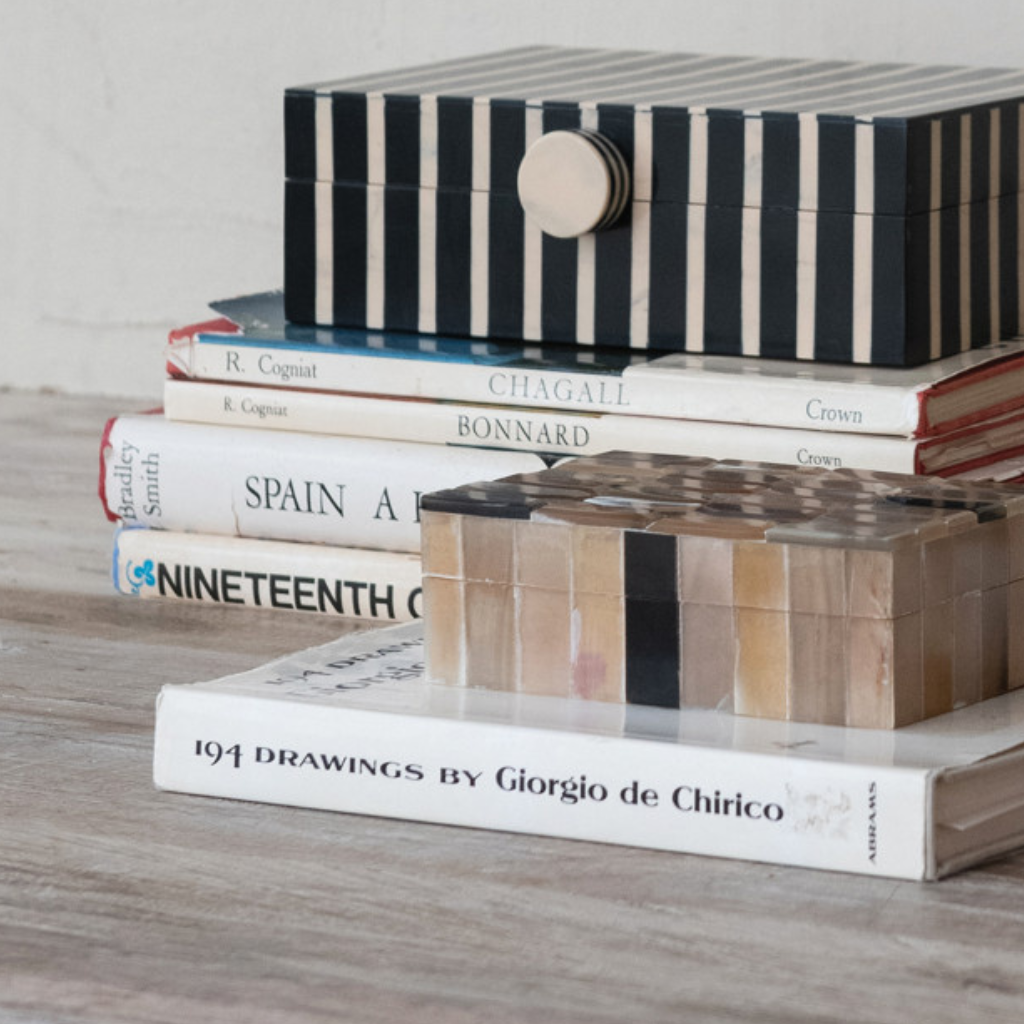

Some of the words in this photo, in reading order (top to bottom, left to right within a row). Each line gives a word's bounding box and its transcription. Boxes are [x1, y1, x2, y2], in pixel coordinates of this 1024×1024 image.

[225, 350, 246, 373] R.
[257, 354, 318, 382] Cogniat
[223, 396, 237, 412] R.
[240, 397, 288, 418] Cogniat
[487, 373, 631, 407] CHAGALL
[456, 414, 591, 448] BONNARD
[805, 398, 863, 424] Crown
[796, 447, 843, 467] Crown
[113, 440, 140, 521] Bradley
[140, 451, 162, 518] Smith
[245, 475, 347, 518] SPAIN
[372, 486, 399, 522] A
[157, 562, 396, 620] NINETEENTH
[194, 738, 243, 770] 194
[254, 745, 426, 781] DRAWINGS
[438, 767, 484, 789] BY
[494, 765, 609, 803] Giorgio
[618, 780, 660, 808] de
[670, 784, 785, 823] Chirico
[867, 780, 878, 865] ABRAMS
